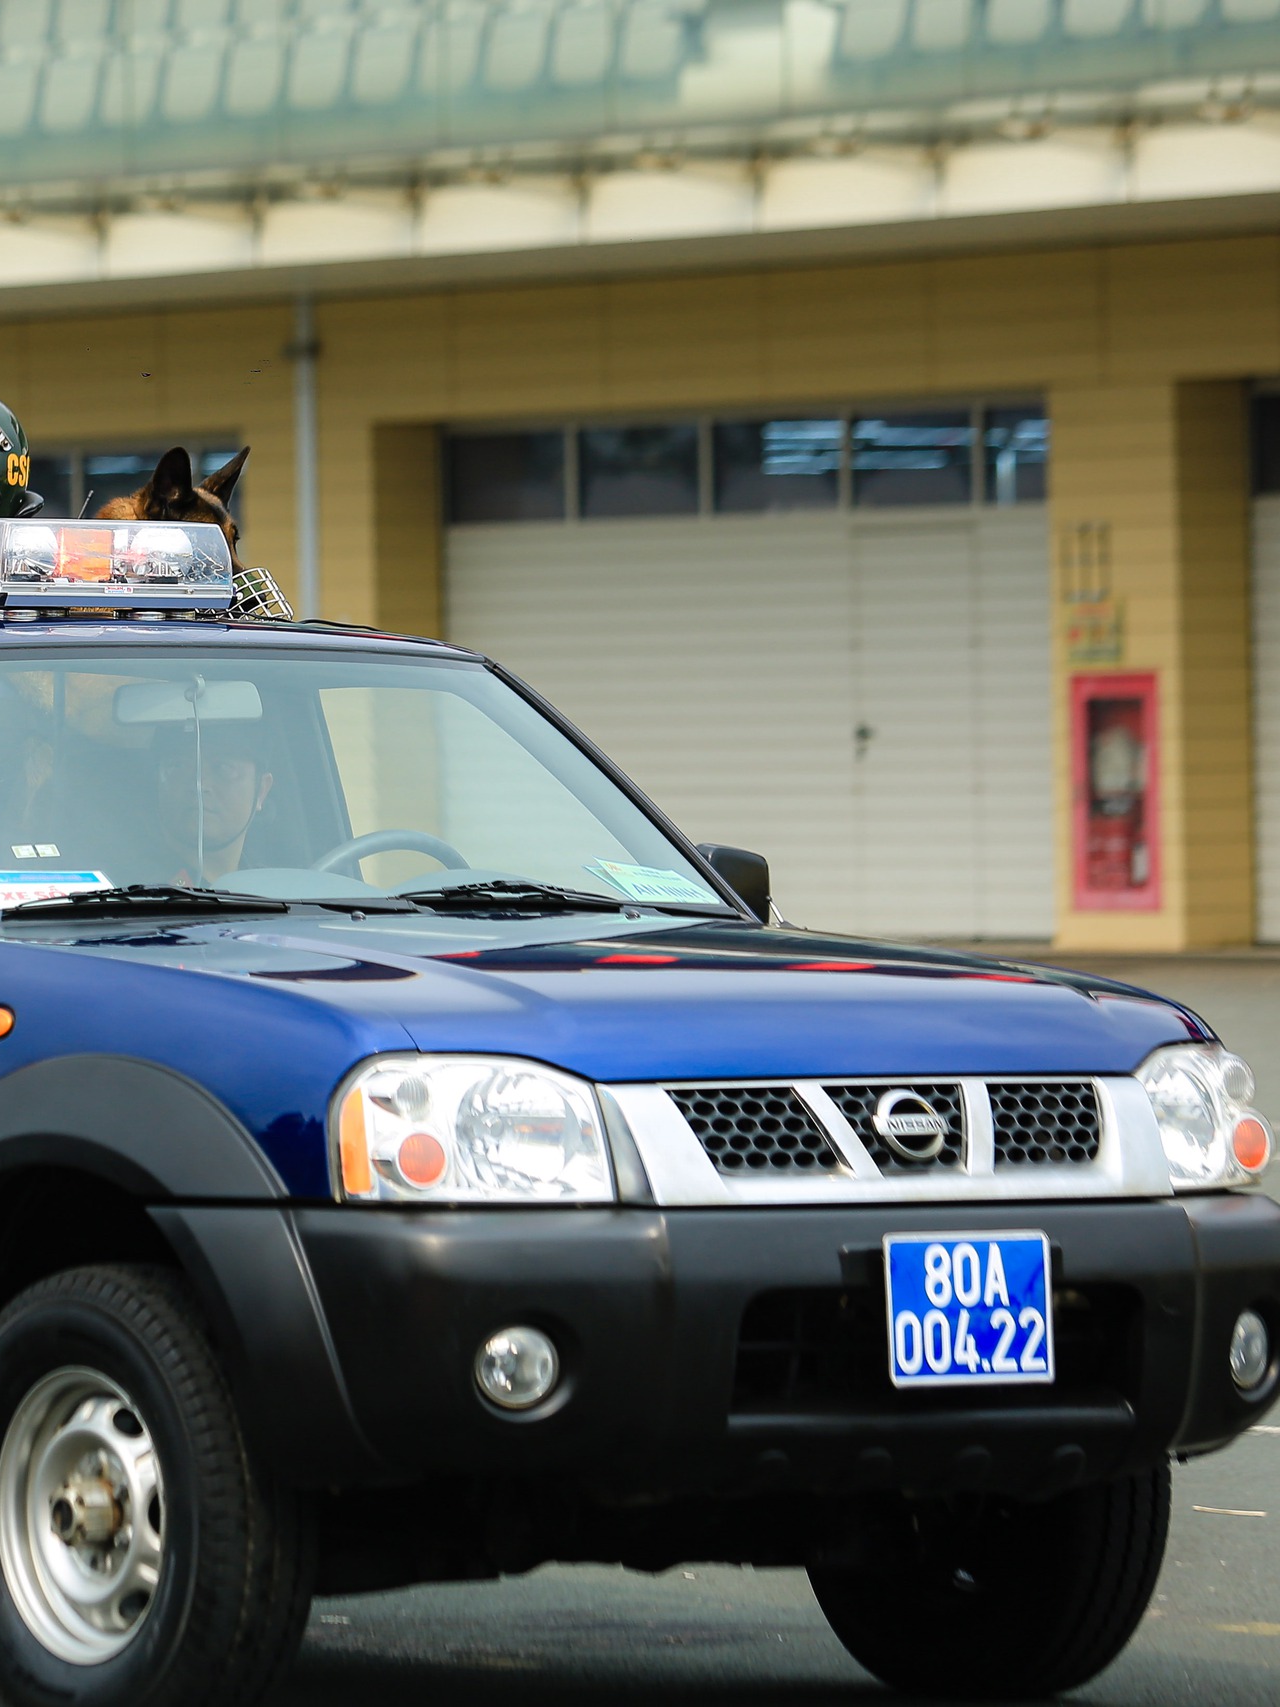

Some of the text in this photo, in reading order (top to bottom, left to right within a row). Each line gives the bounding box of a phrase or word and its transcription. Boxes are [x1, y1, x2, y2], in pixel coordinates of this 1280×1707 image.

[7, 453, 30, 487] CS
[0, 891, 32, 901] XE
[887, 1117, 944, 1132] NISSAN
[924, 1242, 1011, 1309] 80A
[895, 1306, 1047, 1375] 004.22
